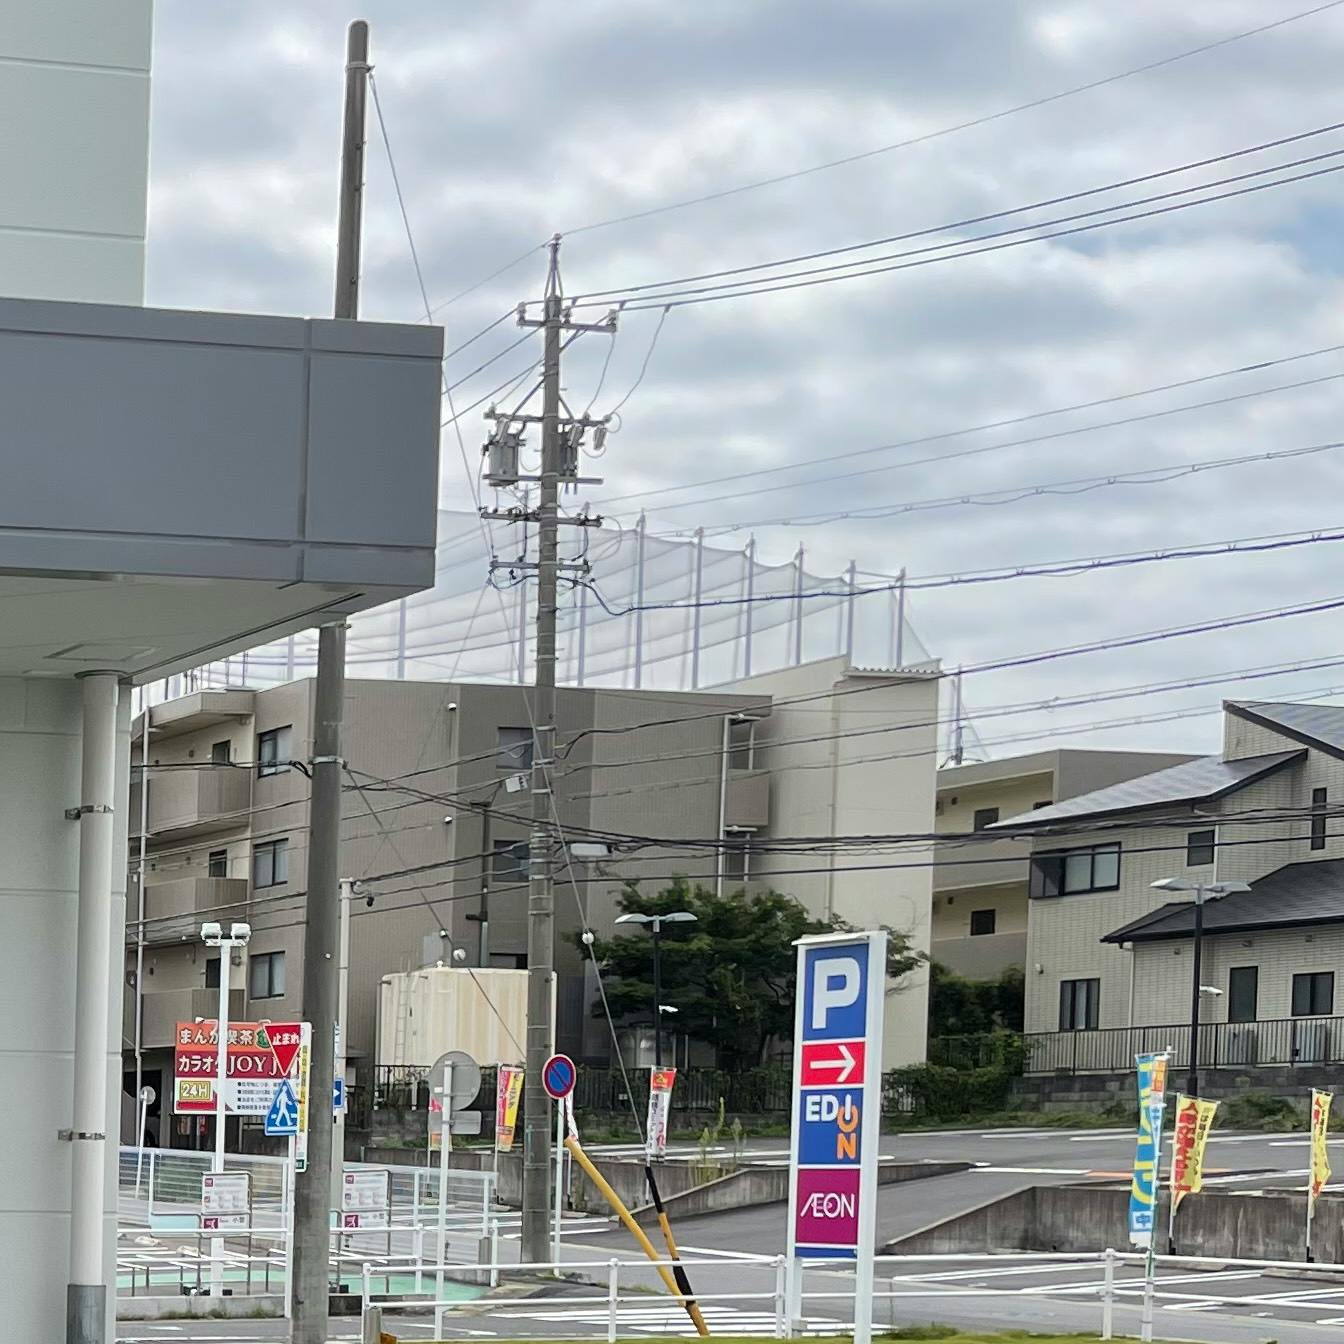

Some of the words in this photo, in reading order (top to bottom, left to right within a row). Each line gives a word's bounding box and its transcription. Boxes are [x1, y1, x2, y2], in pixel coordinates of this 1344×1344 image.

[812, 957, 861, 1030] P
[272, 1033, 300, 1046] 止まれ
[181, 1082, 210, 1099] 24H
[805, 1093, 859, 1160] EDION
